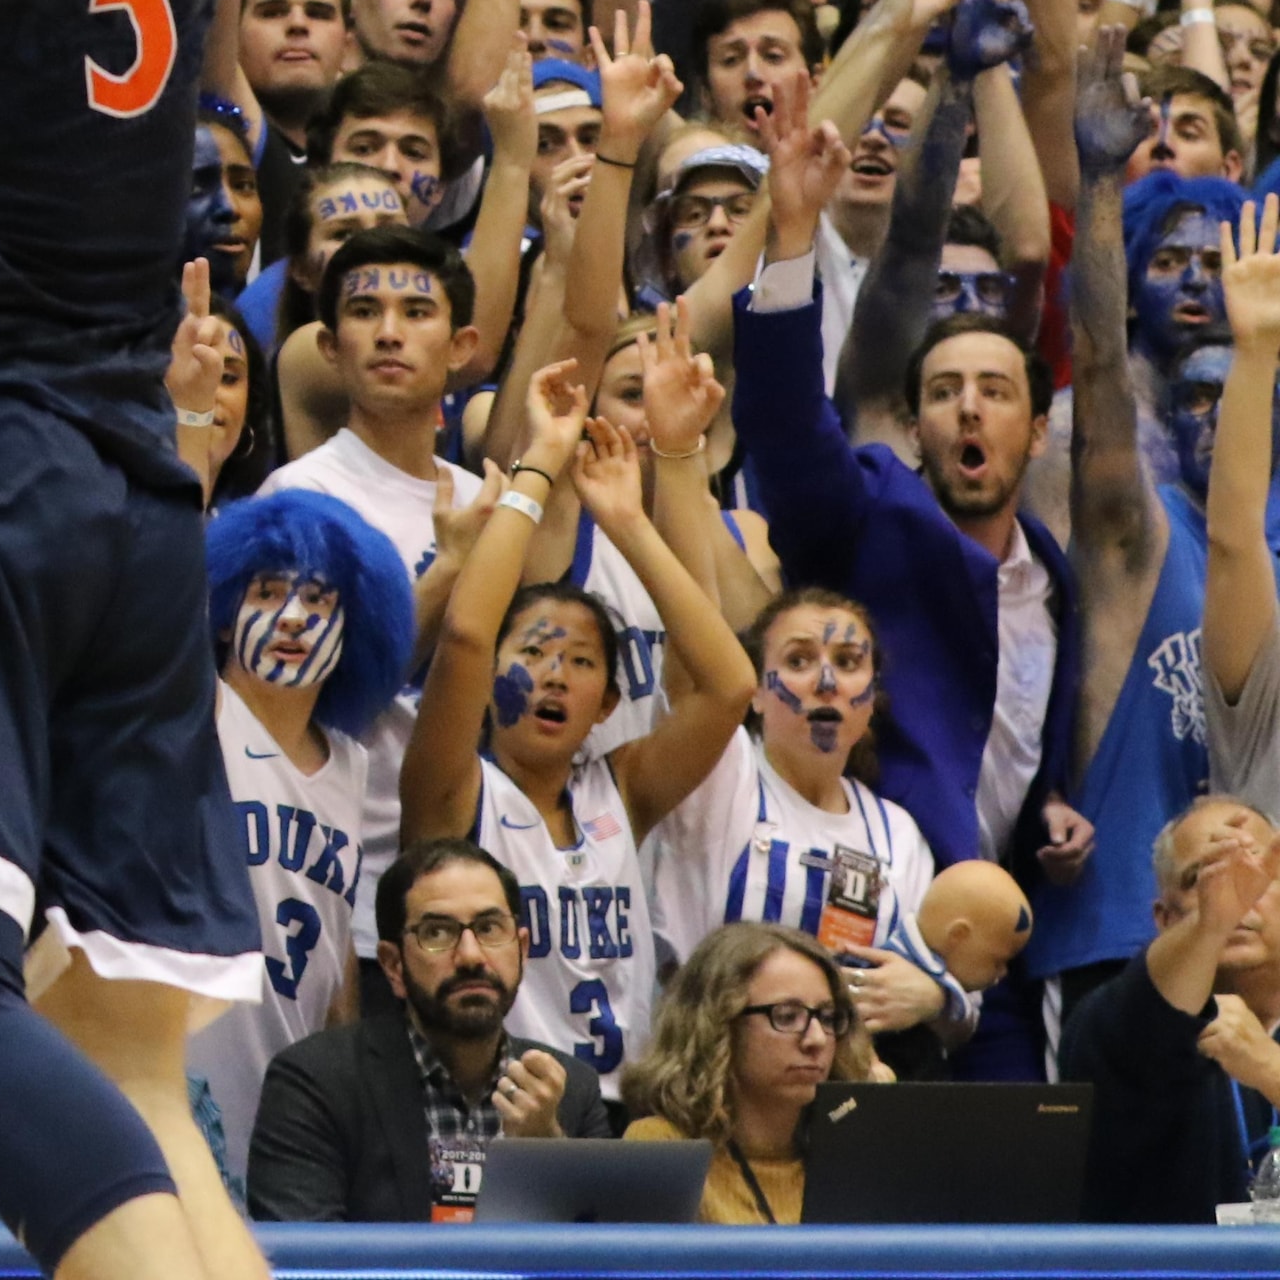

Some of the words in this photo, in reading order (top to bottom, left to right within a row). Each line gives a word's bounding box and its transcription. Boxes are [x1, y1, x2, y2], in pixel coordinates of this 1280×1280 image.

[264, 898, 321, 1001] 3
[519, 886, 633, 960] DUKE
[569, 978, 624, 1076] 3
